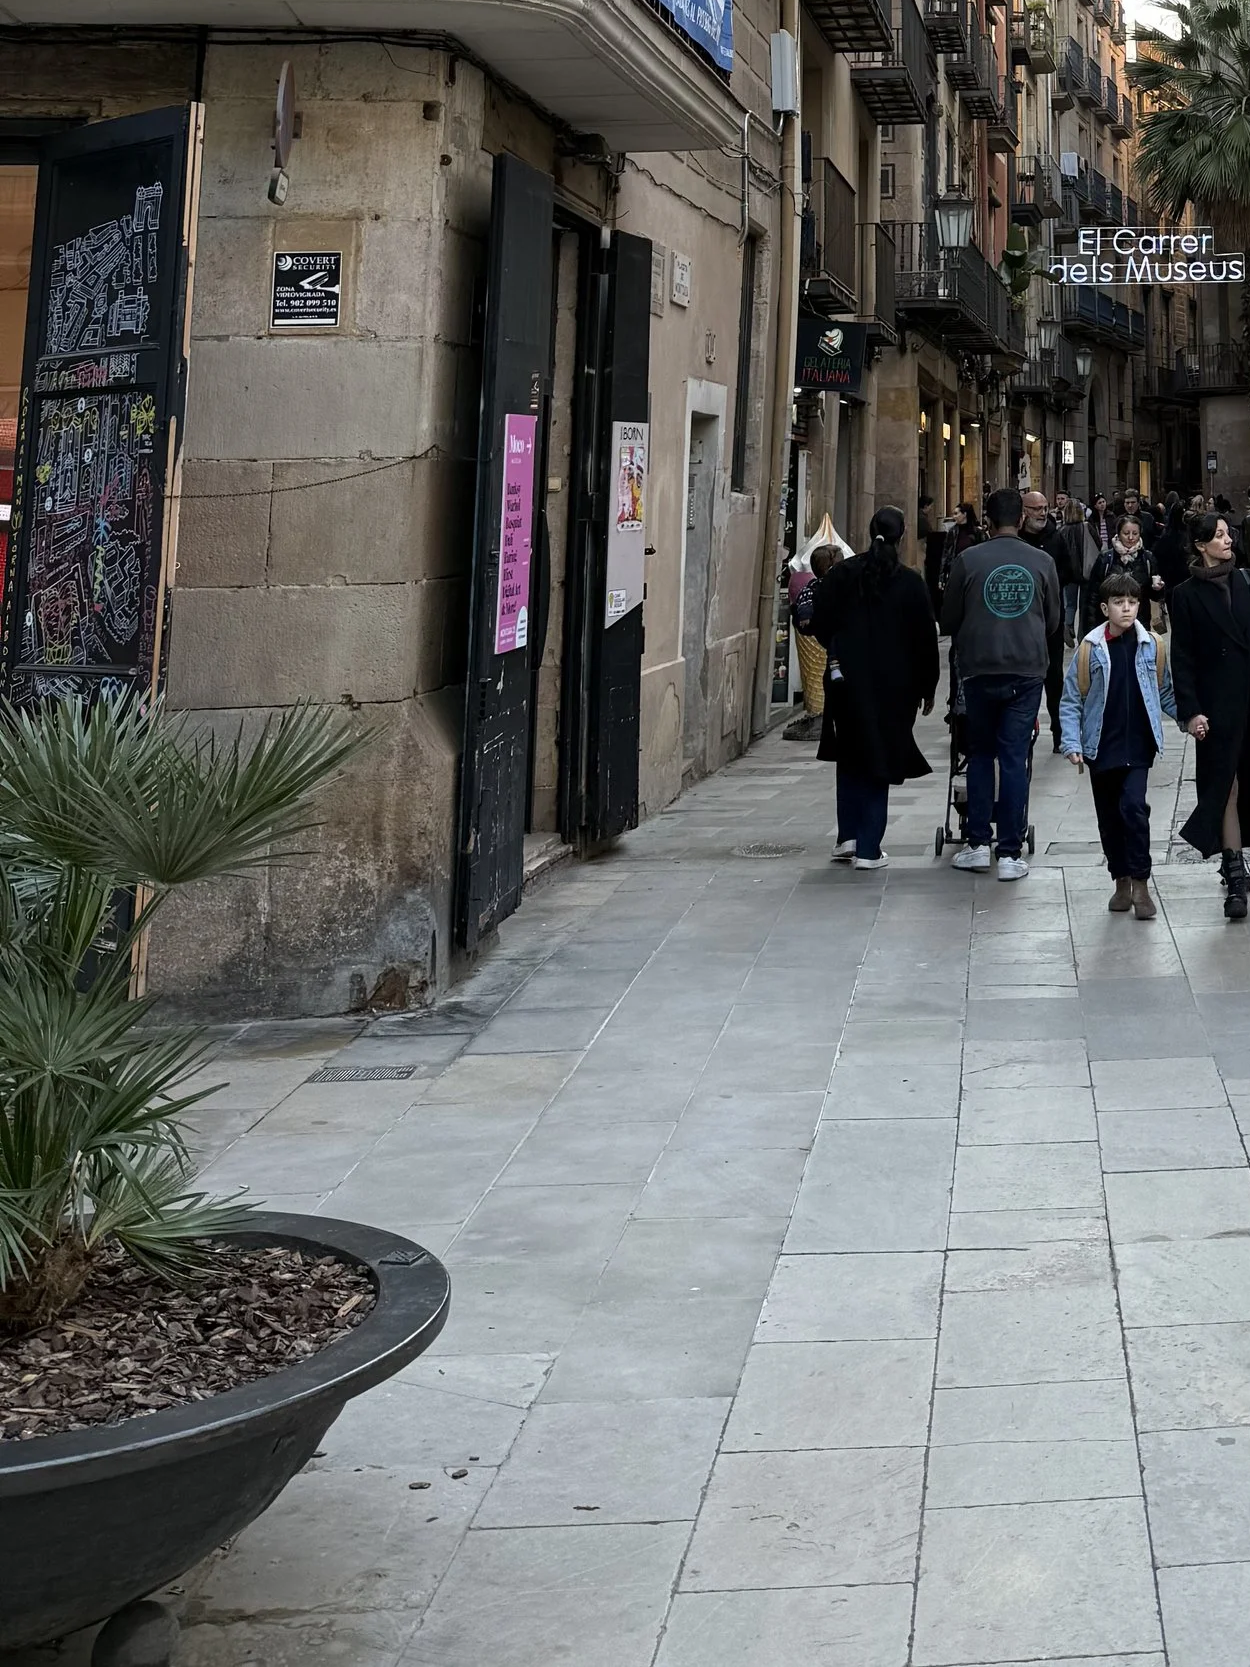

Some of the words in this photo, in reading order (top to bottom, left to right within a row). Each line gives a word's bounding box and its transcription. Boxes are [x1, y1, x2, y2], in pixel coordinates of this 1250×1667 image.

[1079, 228, 1101, 256] El
[1113, 228, 1213, 256] Carrer
[293, 256, 337, 265] COVERT
[1049, 255, 1114, 284] dels
[1125, 255, 1243, 283] Museus
[804, 356, 852, 370] GELATERIA
[800, 368, 851, 383] ITALIANA
[988, 583, 1032, 592] L'EFFET
